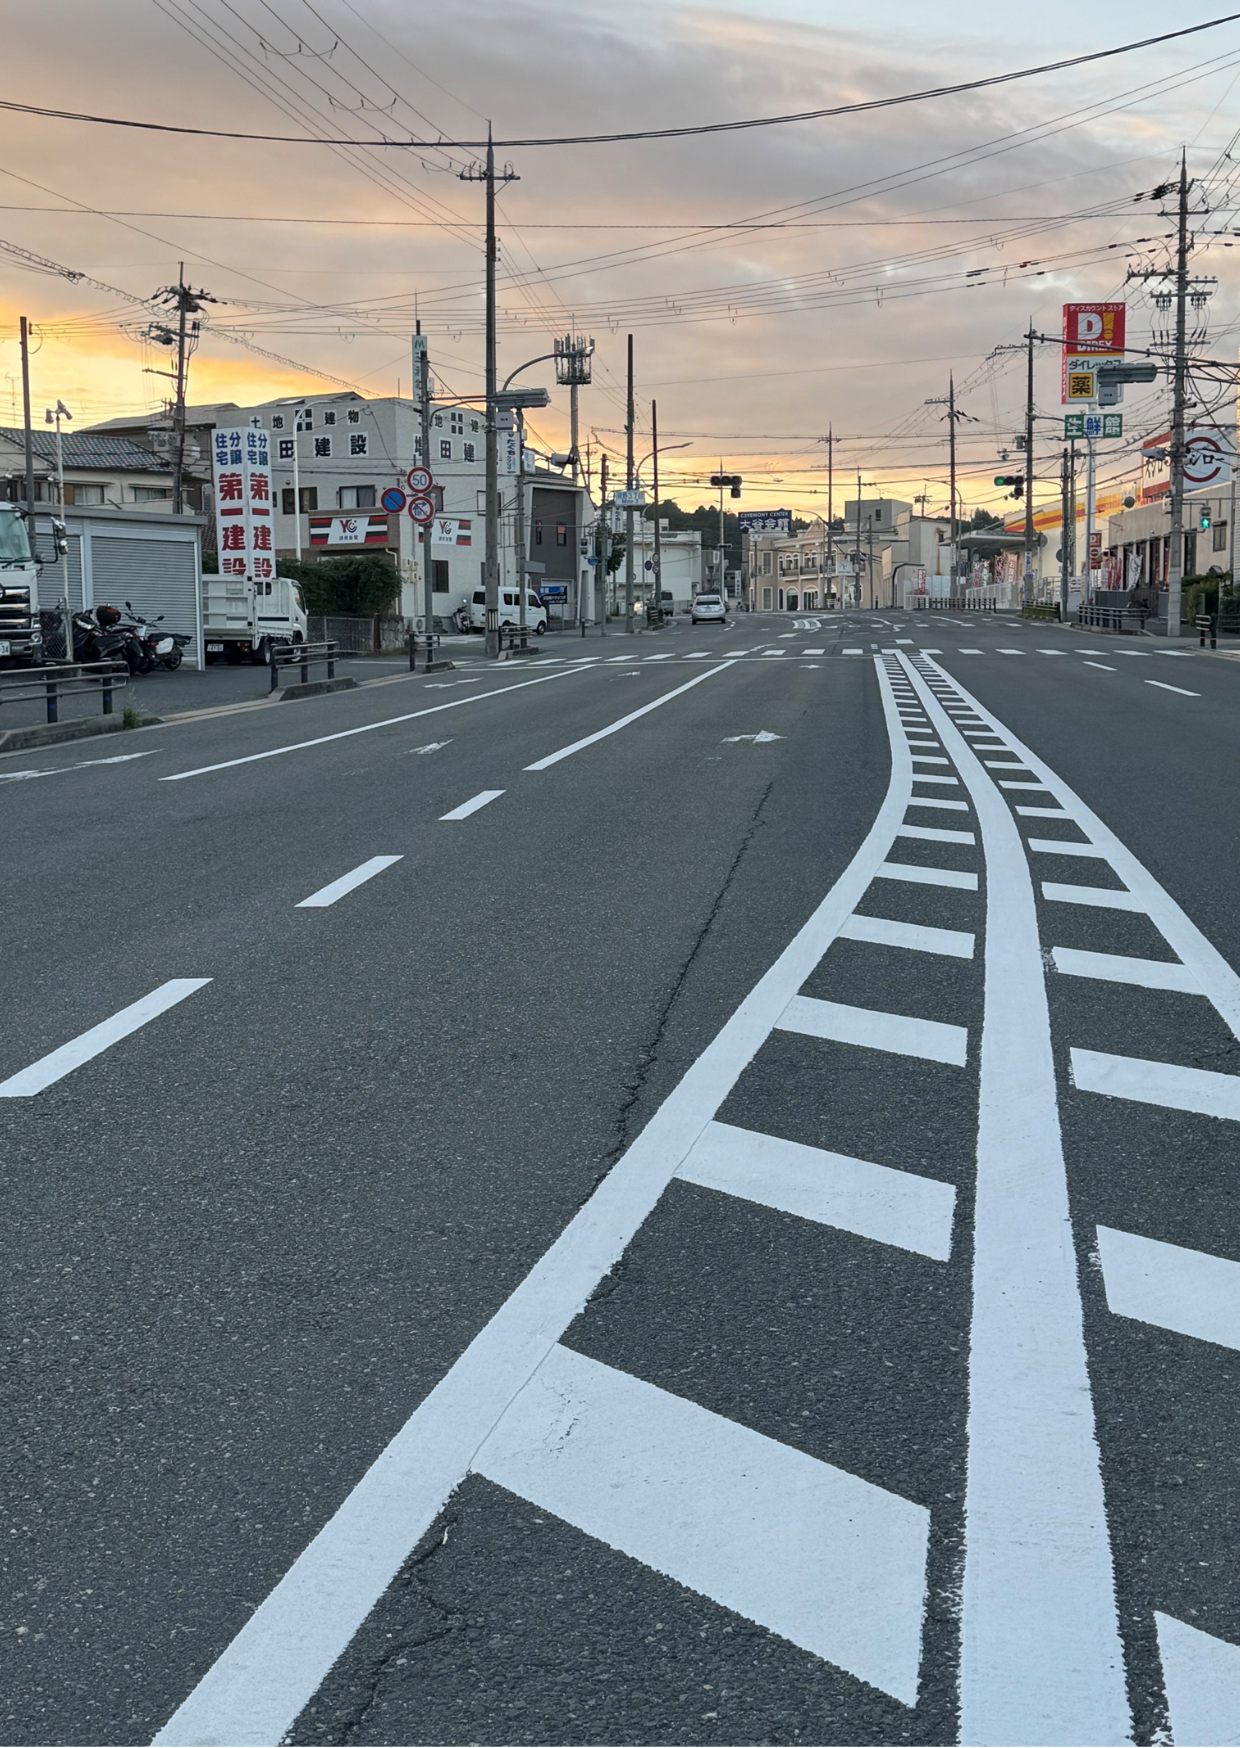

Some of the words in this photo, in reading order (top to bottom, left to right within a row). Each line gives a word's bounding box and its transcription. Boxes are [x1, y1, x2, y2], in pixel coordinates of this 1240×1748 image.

[1072, 376, 1091, 394] 薬
[1066, 416, 1120, 436] 生鮮館
[412, 474, 428, 487] 50
[218, 472, 247, 575] 第一建設
[249, 472, 273, 578] 第一建設
[740, 518, 789, 531] 大谷会館
